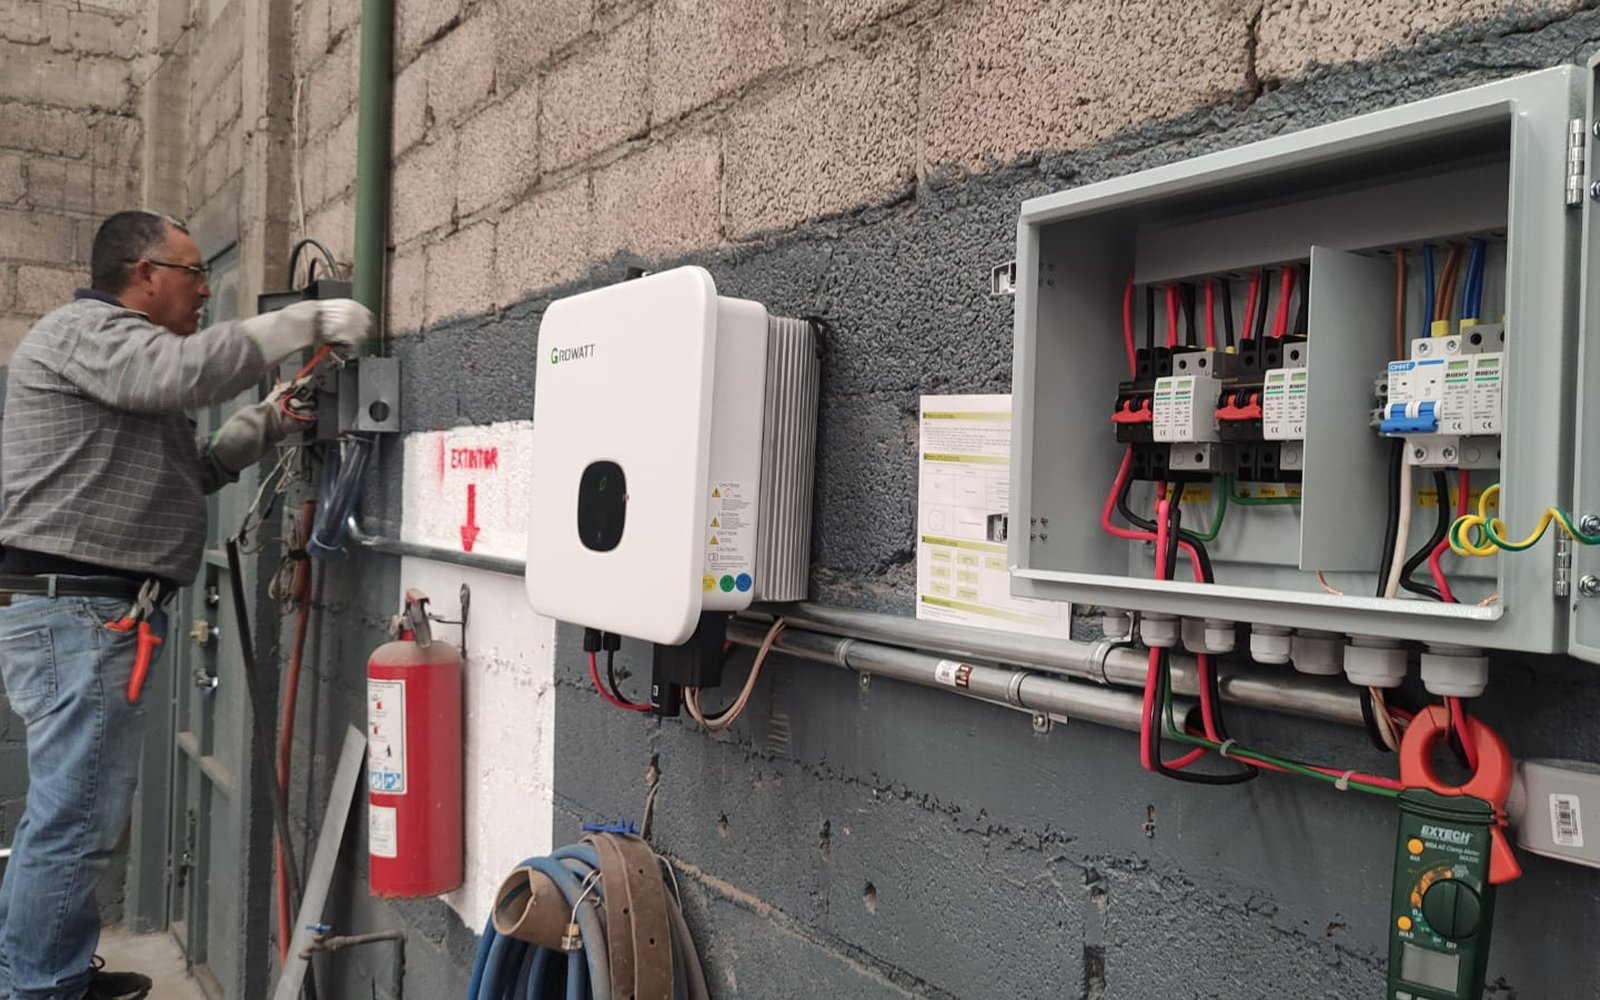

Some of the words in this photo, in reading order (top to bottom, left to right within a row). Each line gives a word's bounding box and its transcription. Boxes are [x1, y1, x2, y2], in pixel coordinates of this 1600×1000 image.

[551, 344, 595, 364] GROWATT
[451, 447, 498, 470] EXTINTOR
[1421, 825, 1472, 844] EXTECH
